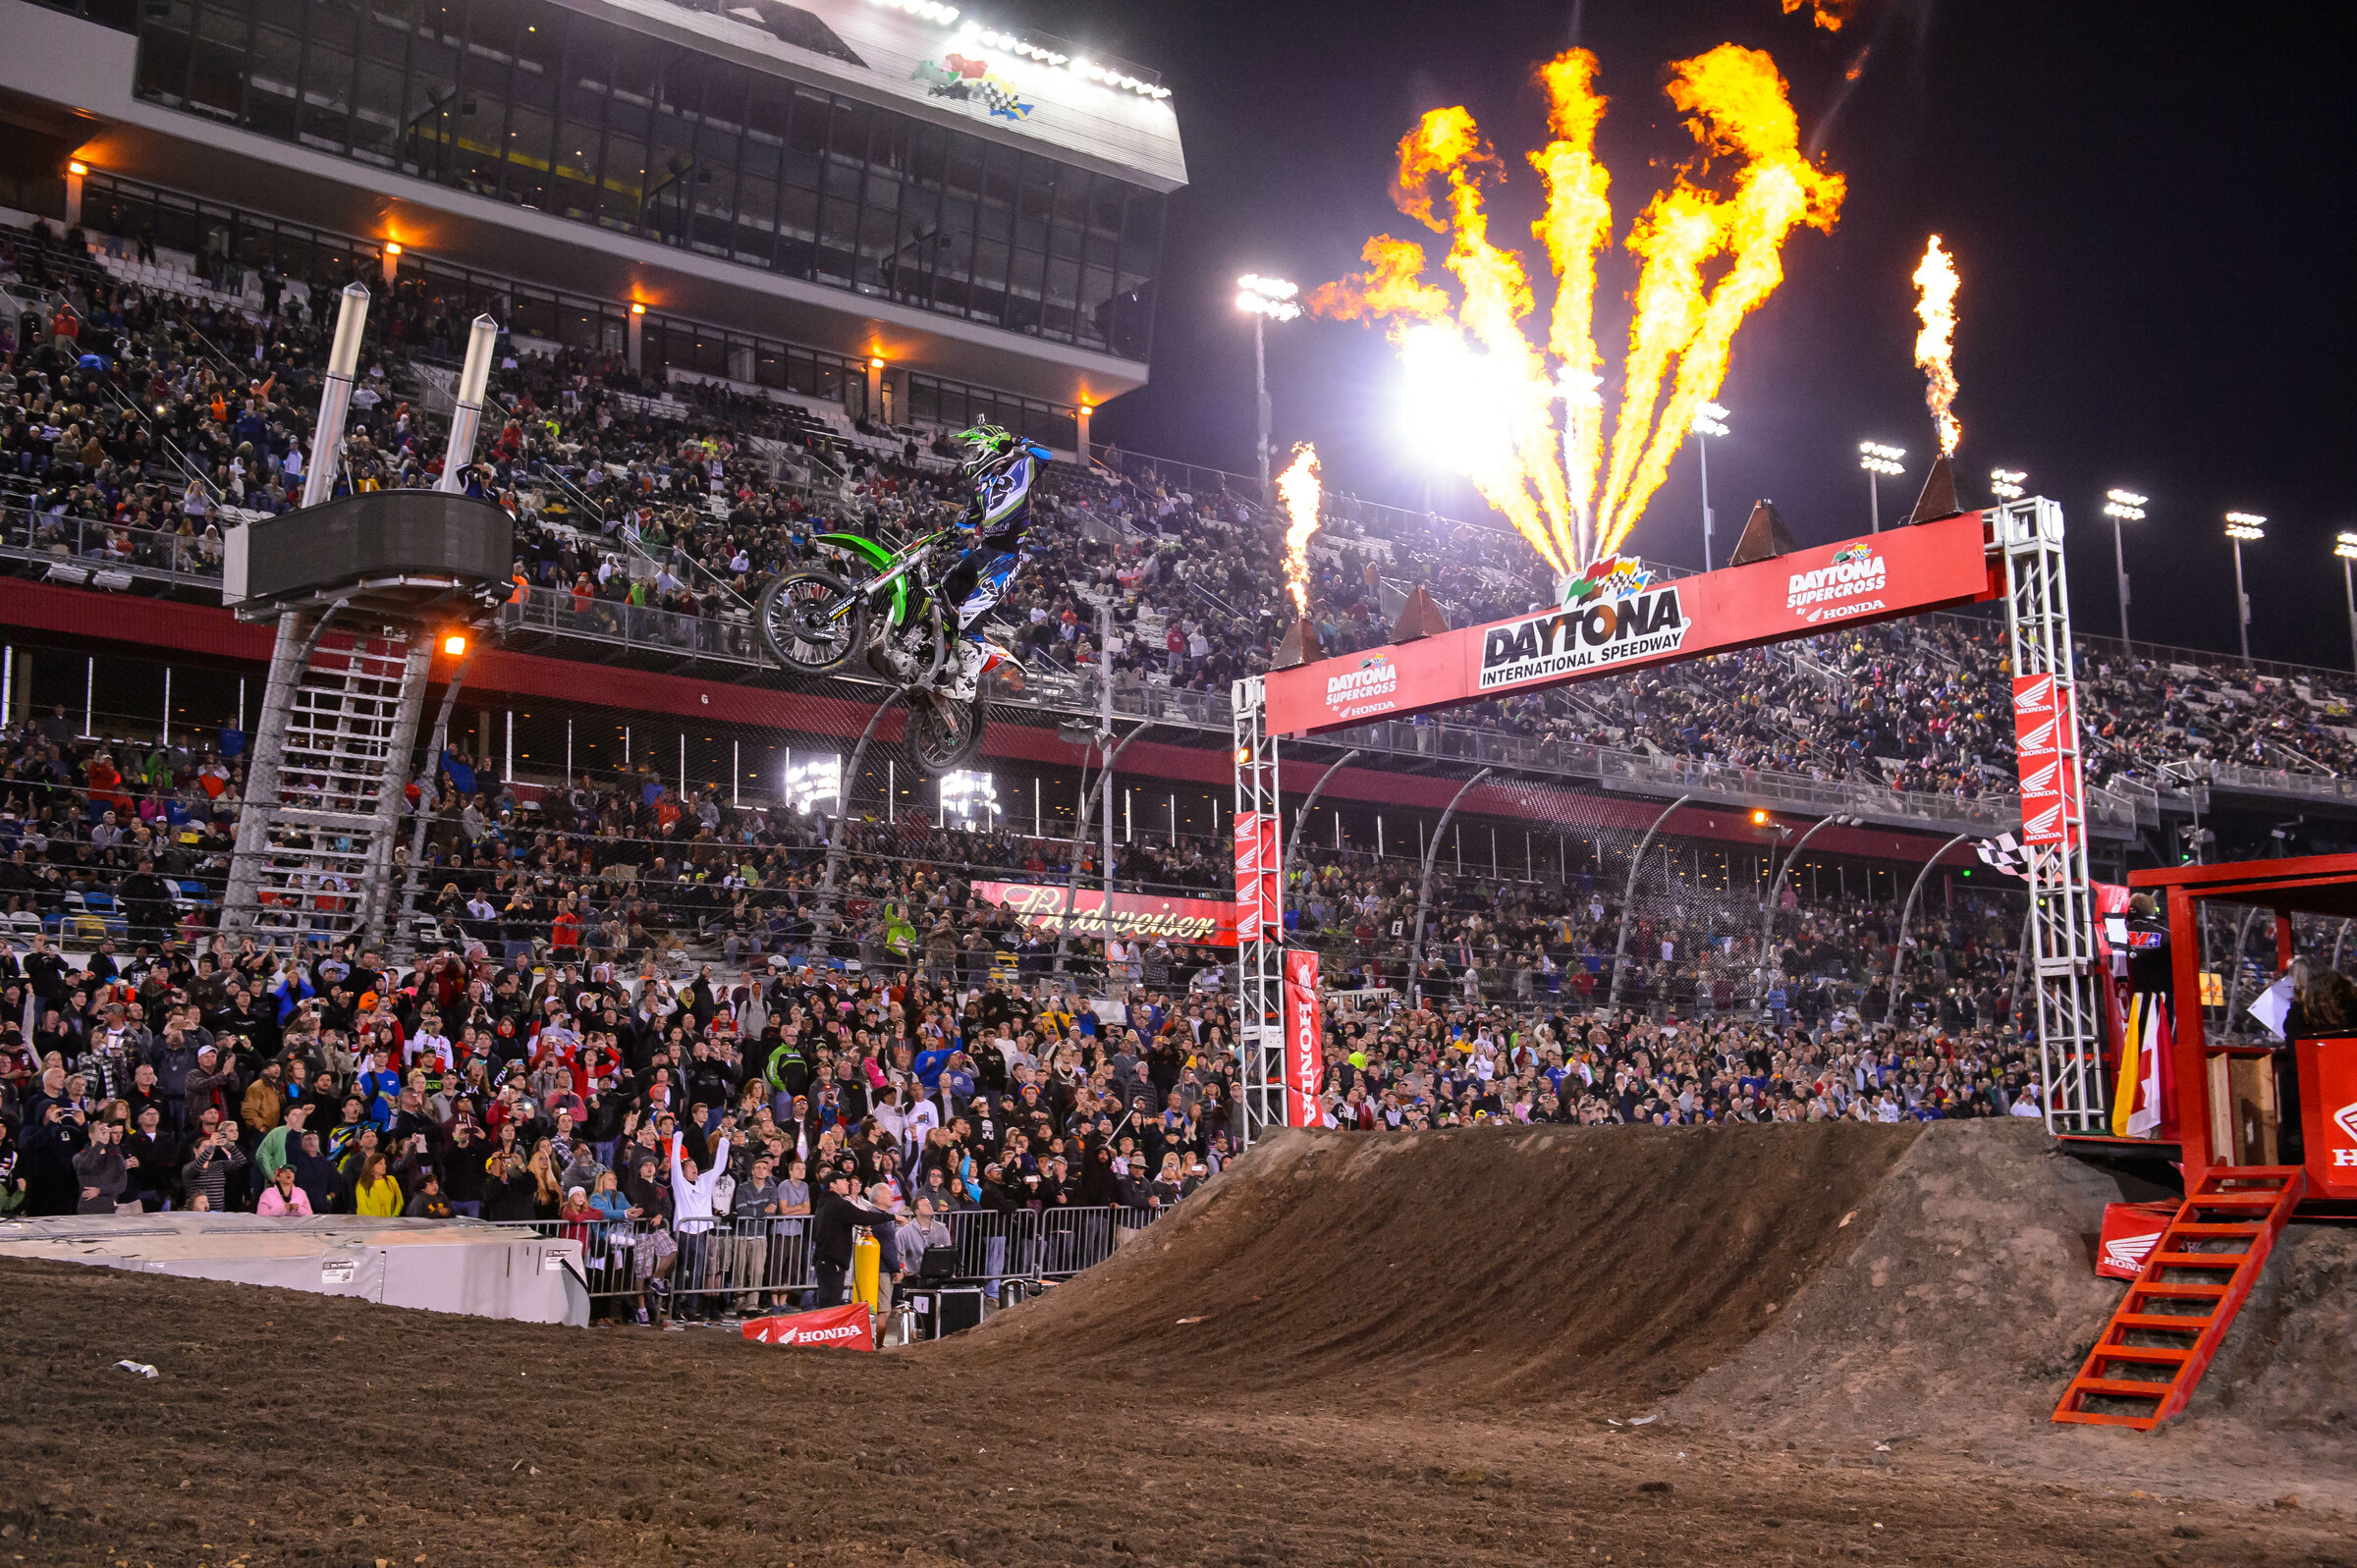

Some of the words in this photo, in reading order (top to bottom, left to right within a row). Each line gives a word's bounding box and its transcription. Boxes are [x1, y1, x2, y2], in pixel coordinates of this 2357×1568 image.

[1788, 556, 1886, 595] DAYTONA
[1786, 574, 1886, 609] SUPERCROSS
[828, 595, 856, 618] DUNLOP
[1822, 599, 1886, 620] HONDA
[1483, 589, 1682, 669] DAYTONA
[1482, 651, 1595, 686] INTERNATIONAL
[1601, 631, 1681, 662] SPEEDWAY
[1327, 664, 1397, 693] DAYTONA
[1325, 679, 1397, 706] SUPERCROSS
[1350, 700, 1396, 717] HONDA
[2016, 704, 2054, 715] HONDA
[2019, 746, 2057, 758] HONDA
[2022, 788, 2059, 799] HONDA
[2025, 831, 2062, 841] HONDA
[1298, 1000, 1316, 1127] HONDA
[2104, 1256, 2146, 1272] HON
[797, 1325, 862, 1343] HONDA
